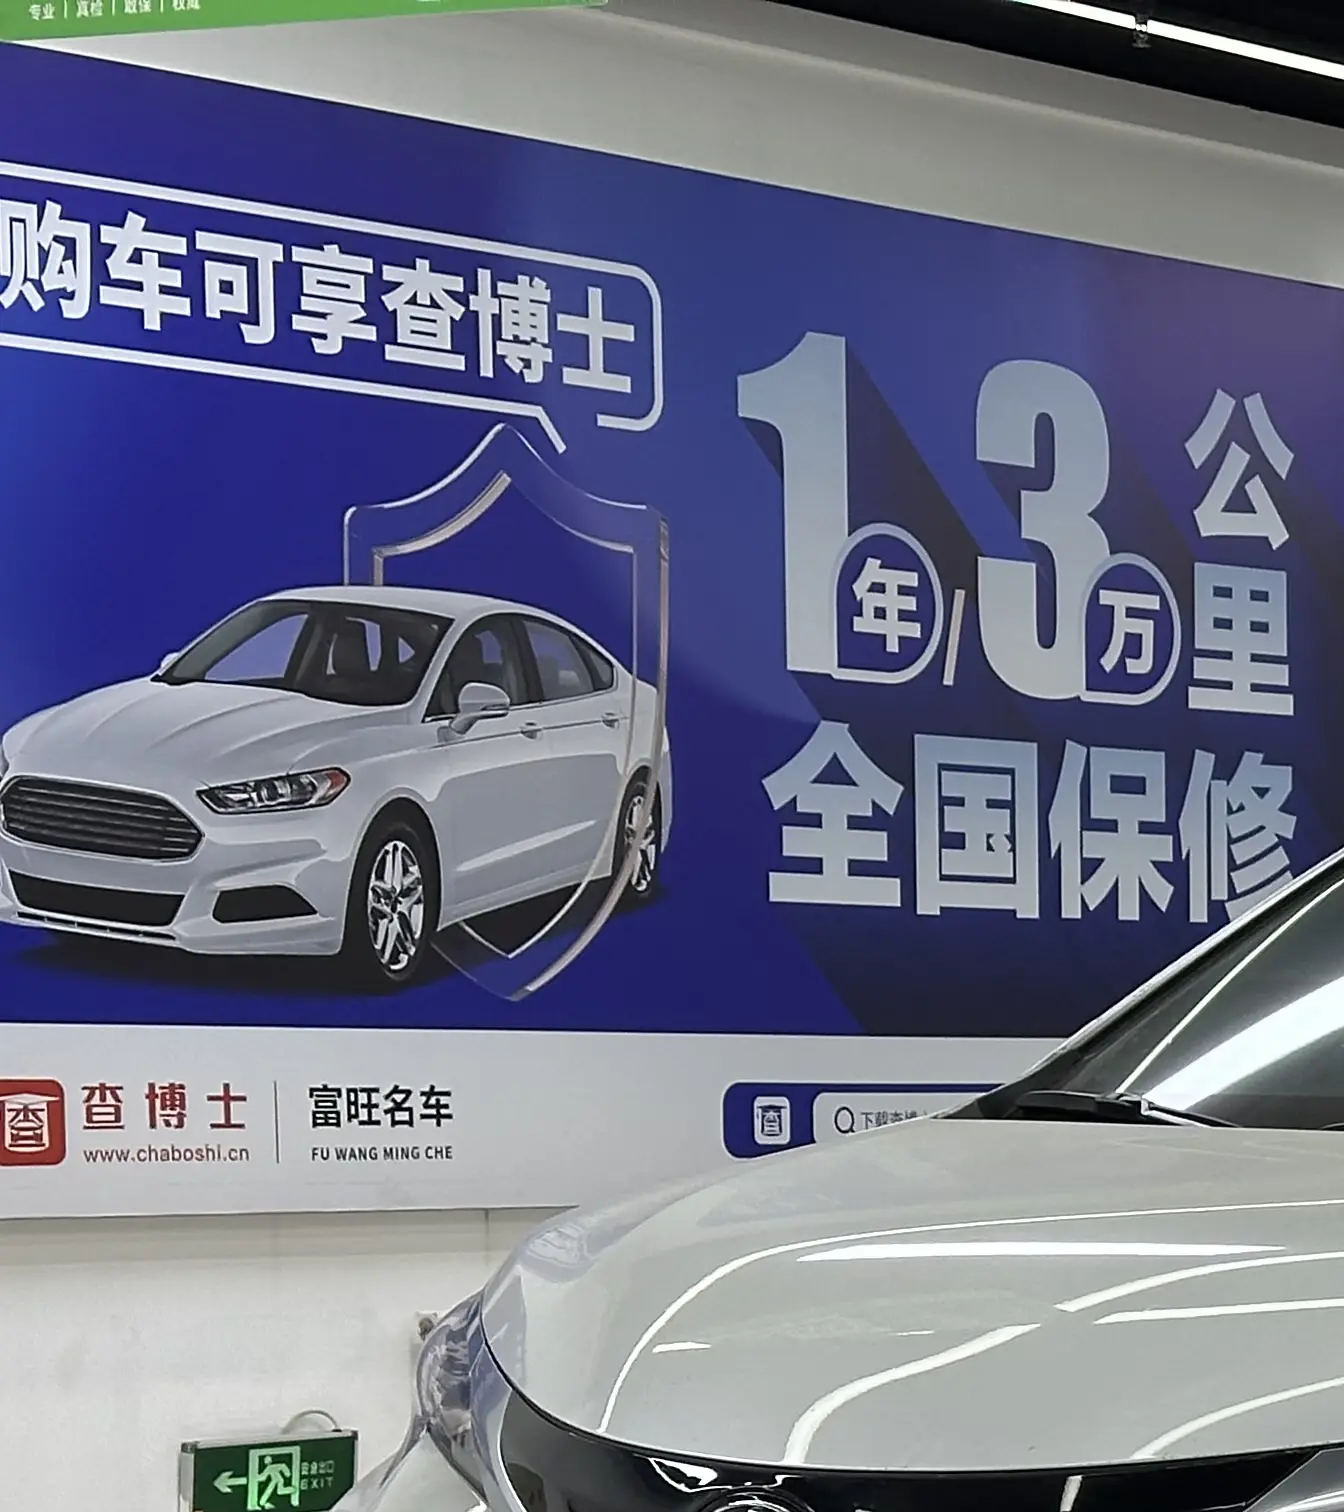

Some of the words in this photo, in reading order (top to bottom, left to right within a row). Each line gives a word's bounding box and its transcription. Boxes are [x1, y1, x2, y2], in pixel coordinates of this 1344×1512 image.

[28, 3, 55, 20] 专业
[0, 199, 635, 393] 购车可享查博士
[762, 720, 1297, 923] 全国保修
[81, 1081, 248, 1131] 查博士
[308, 1084, 454, 1129] 富旺名车
[83, 1143, 249, 1164] www.chaboshi.cn
[311, 1147, 330, 1161] FU
[335, 1146, 378, 1161] WANG
[383, 1146, 420, 1161] MING
[425, 1145, 453, 1160] CHE
[301, 1476, 334, 1490] EXIT
